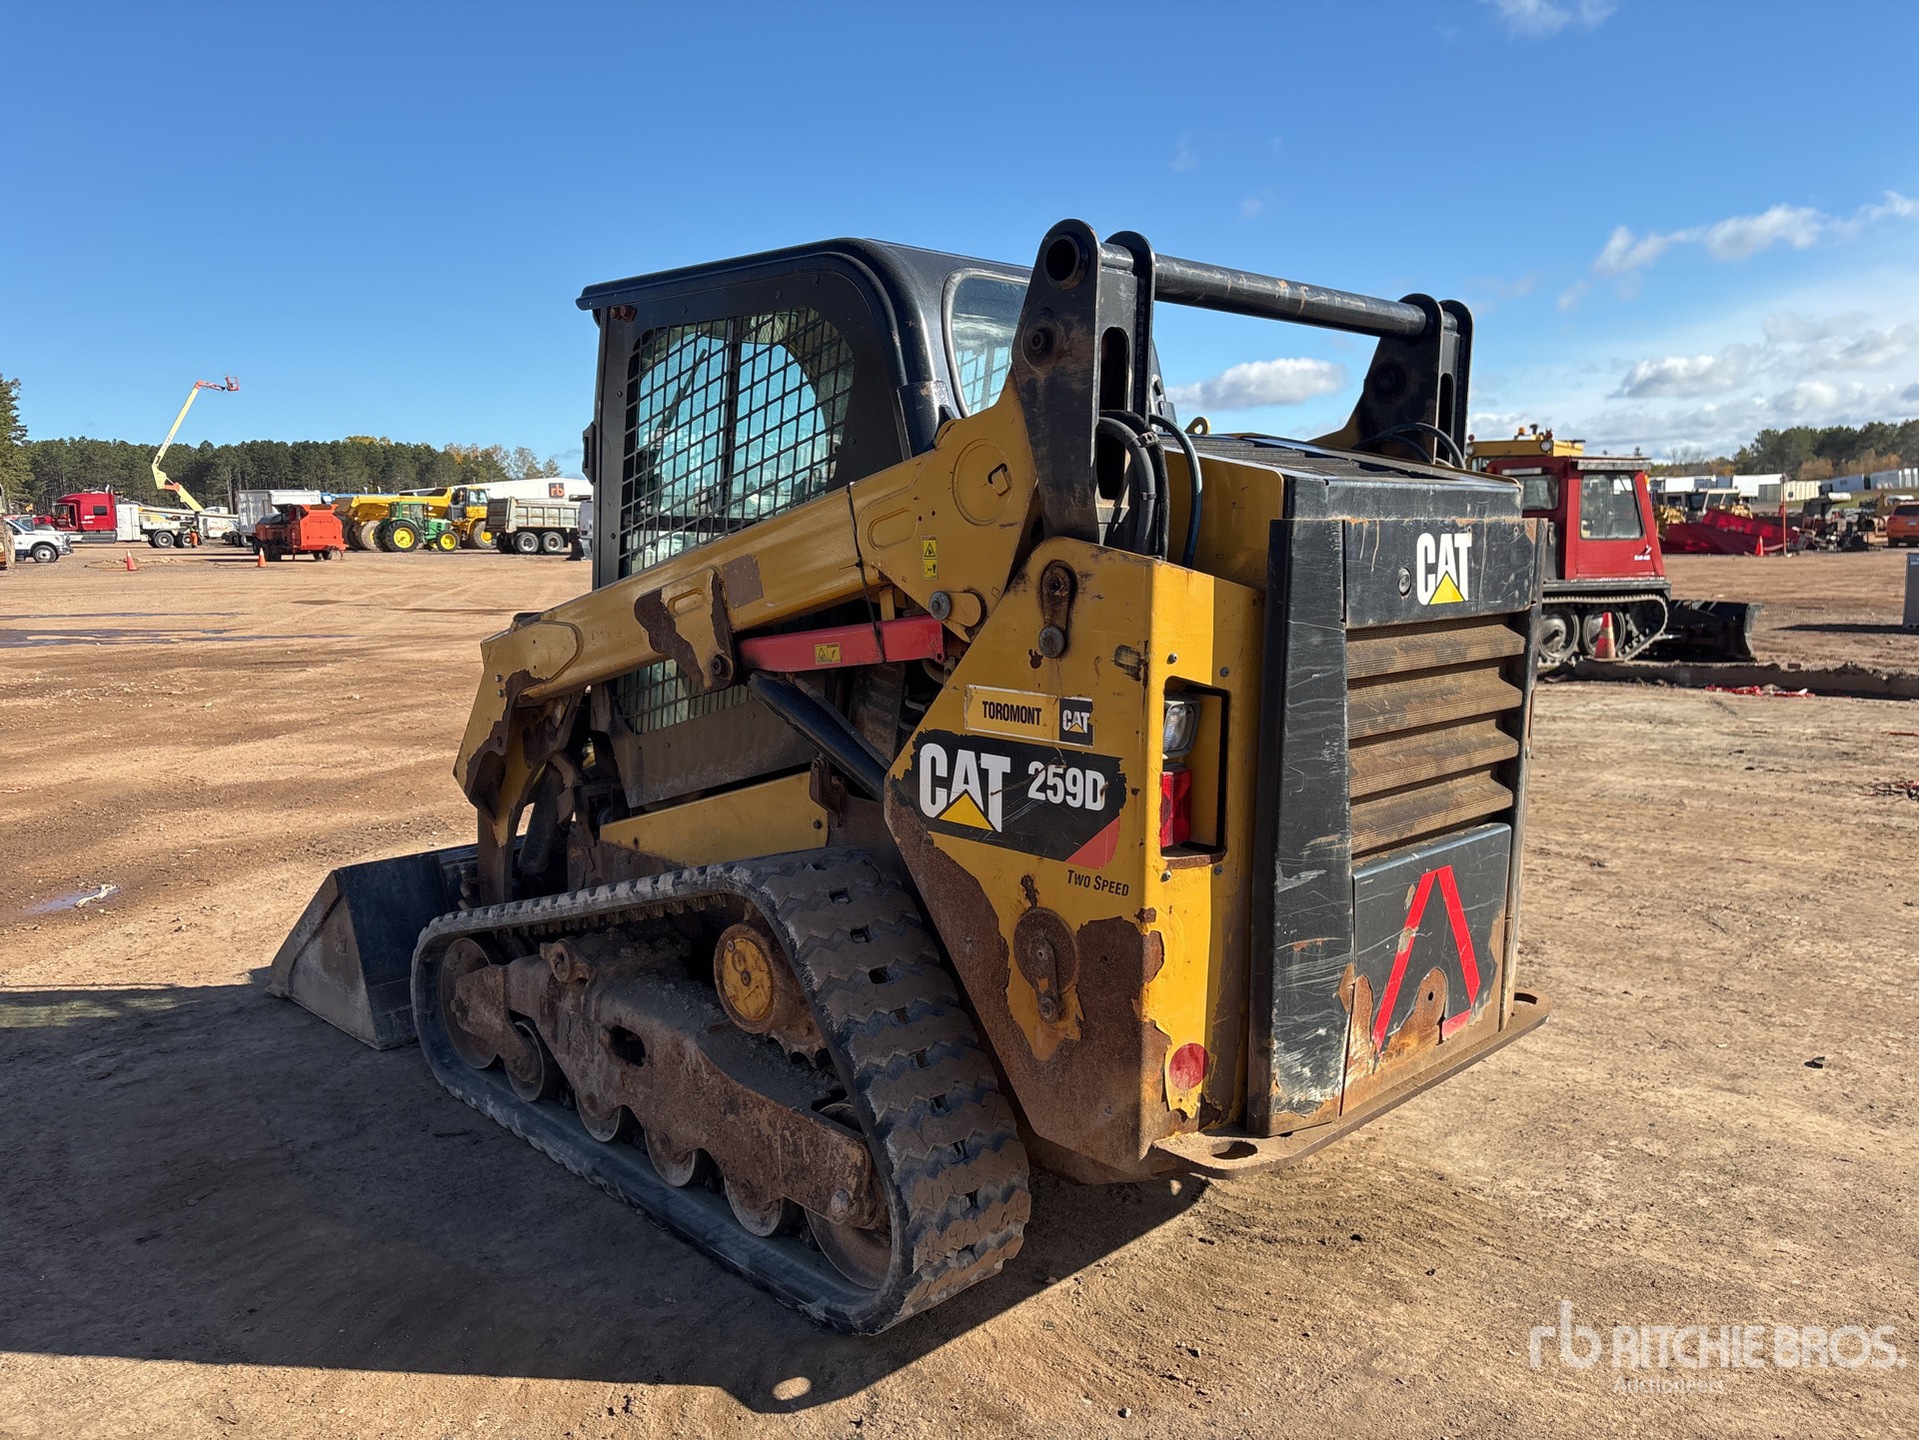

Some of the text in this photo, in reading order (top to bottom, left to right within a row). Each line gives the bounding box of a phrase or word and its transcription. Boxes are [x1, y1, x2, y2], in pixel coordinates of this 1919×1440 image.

[551, 484, 565, 497] rb
[1416, 532, 1473, 606] CAT
[981, 700, 1042, 726] TOROMONT
[1062, 709, 1091, 733] CAT
[919, 743, 1011, 833] CAT
[1027, 760, 1107, 812] 259D
